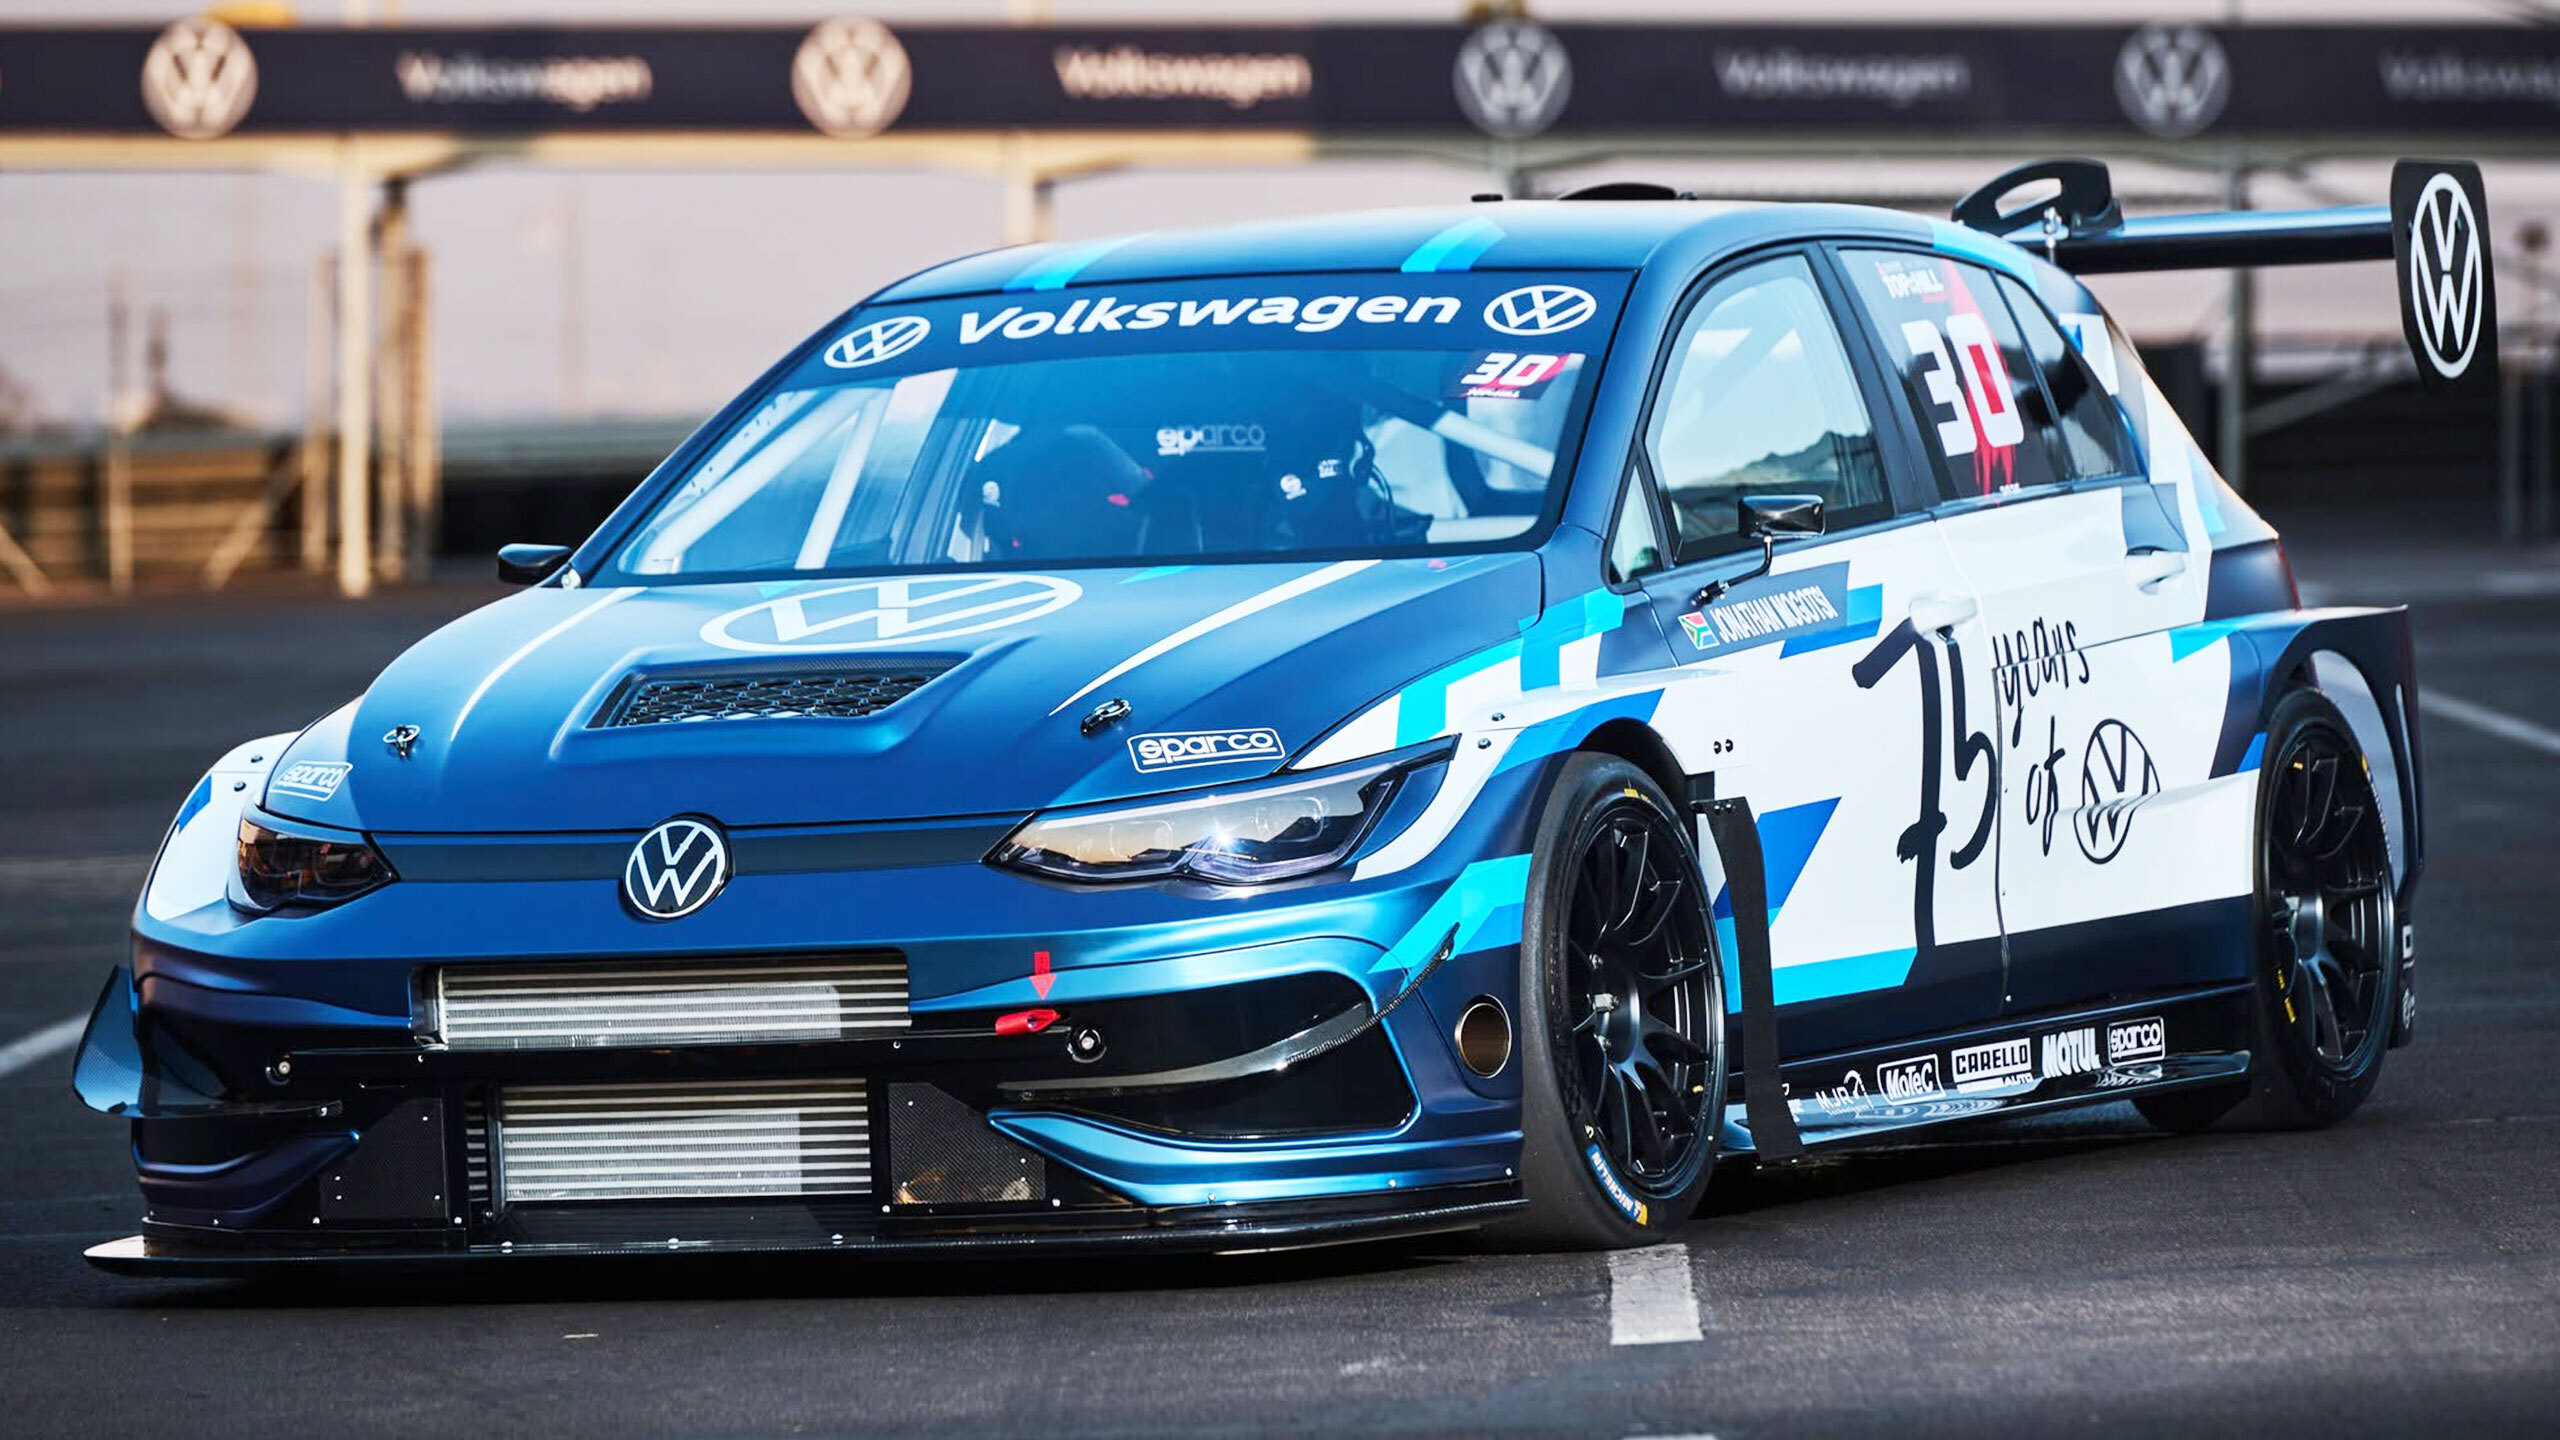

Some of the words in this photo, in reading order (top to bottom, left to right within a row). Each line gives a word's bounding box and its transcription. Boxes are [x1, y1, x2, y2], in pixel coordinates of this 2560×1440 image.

[2378, 50, 2560, 104] Volkswa
[960, 295, 1461, 345] Volkswagen
[1460, 352, 1559, 386] 30
[1901, 312, 2024, 457] 30
[1156, 423, 1265, 456] sparco
[1709, 596, 1785, 643] JONATHAN
[1138, 732, 1277, 765] sparco
[276, 764, 344, 793] sparco
[2042, 1028, 2101, 1078] MOTUL
[2110, 1023, 2161, 1058] sparco
[1956, 1044, 2028, 1075] CARELLO
[1815, 1086, 1854, 1110] MJR
